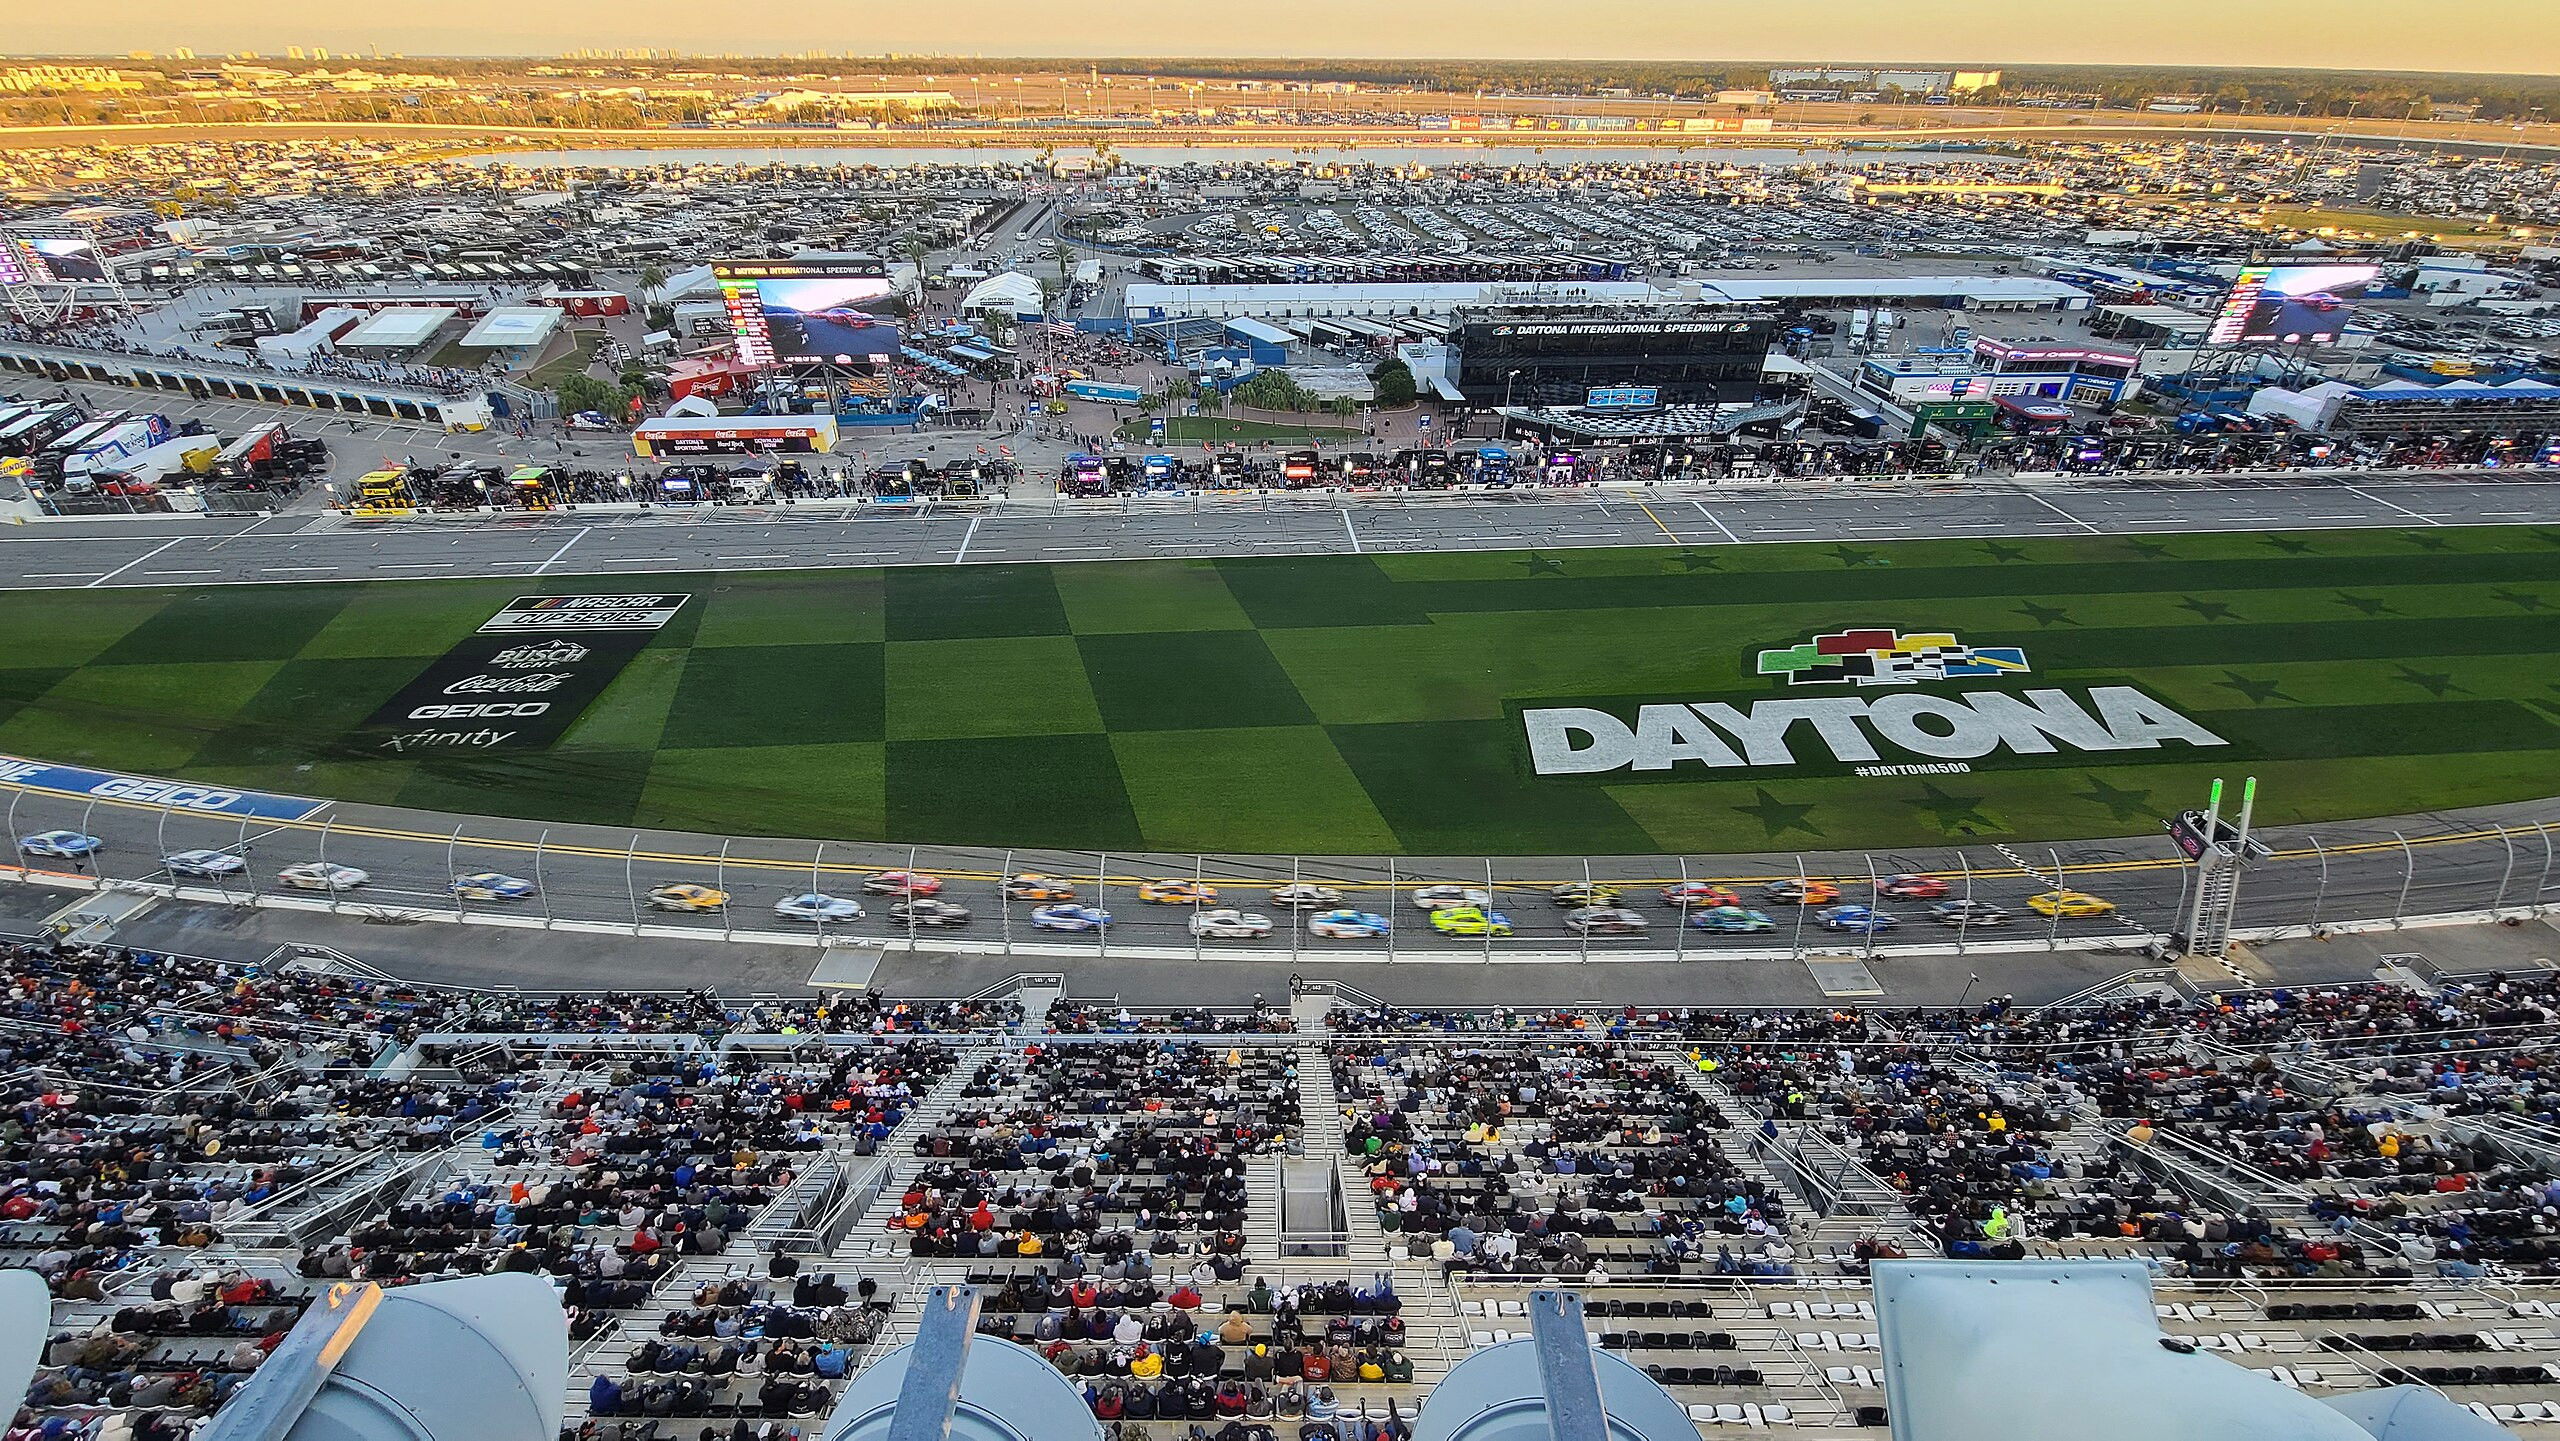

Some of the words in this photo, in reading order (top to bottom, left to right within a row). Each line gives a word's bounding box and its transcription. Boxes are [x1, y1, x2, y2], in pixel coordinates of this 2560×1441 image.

[734, 267, 768, 275] DAYTONA
[770, 266, 825, 275] INTERNATIONAL
[826, 266, 862, 274] SPEEDWAY
[1516, 325, 1567, 335] DAYTONA
[1569, 324, 1661, 334] INTERNATIONAL
[1663, 323, 1727, 333] SPEEDWAY
[644, 431, 667, 440] Coca-Cola
[715, 430, 737, 439] Coca-Cola
[785, 429, 807, 437] Coca-Cola
[731, 440, 745, 448] Rock
[564, 596, 664, 608] NASCAR
[513, 611, 561, 624] CUP
[562, 611, 652, 623] SERIES
[488, 647, 591, 665] BUSCH
[501, 661, 557, 669] LIGHT
[442, 672, 576, 695] Coca-Cola
[407, 702, 551, 720] GEICO
[1522, 686, 2231, 776] DAYTONA
[380, 728, 517, 752] xfinity
[1854, 762, 1971, 777] #DAYTONA500
[89, 778, 243, 809] GEICO
